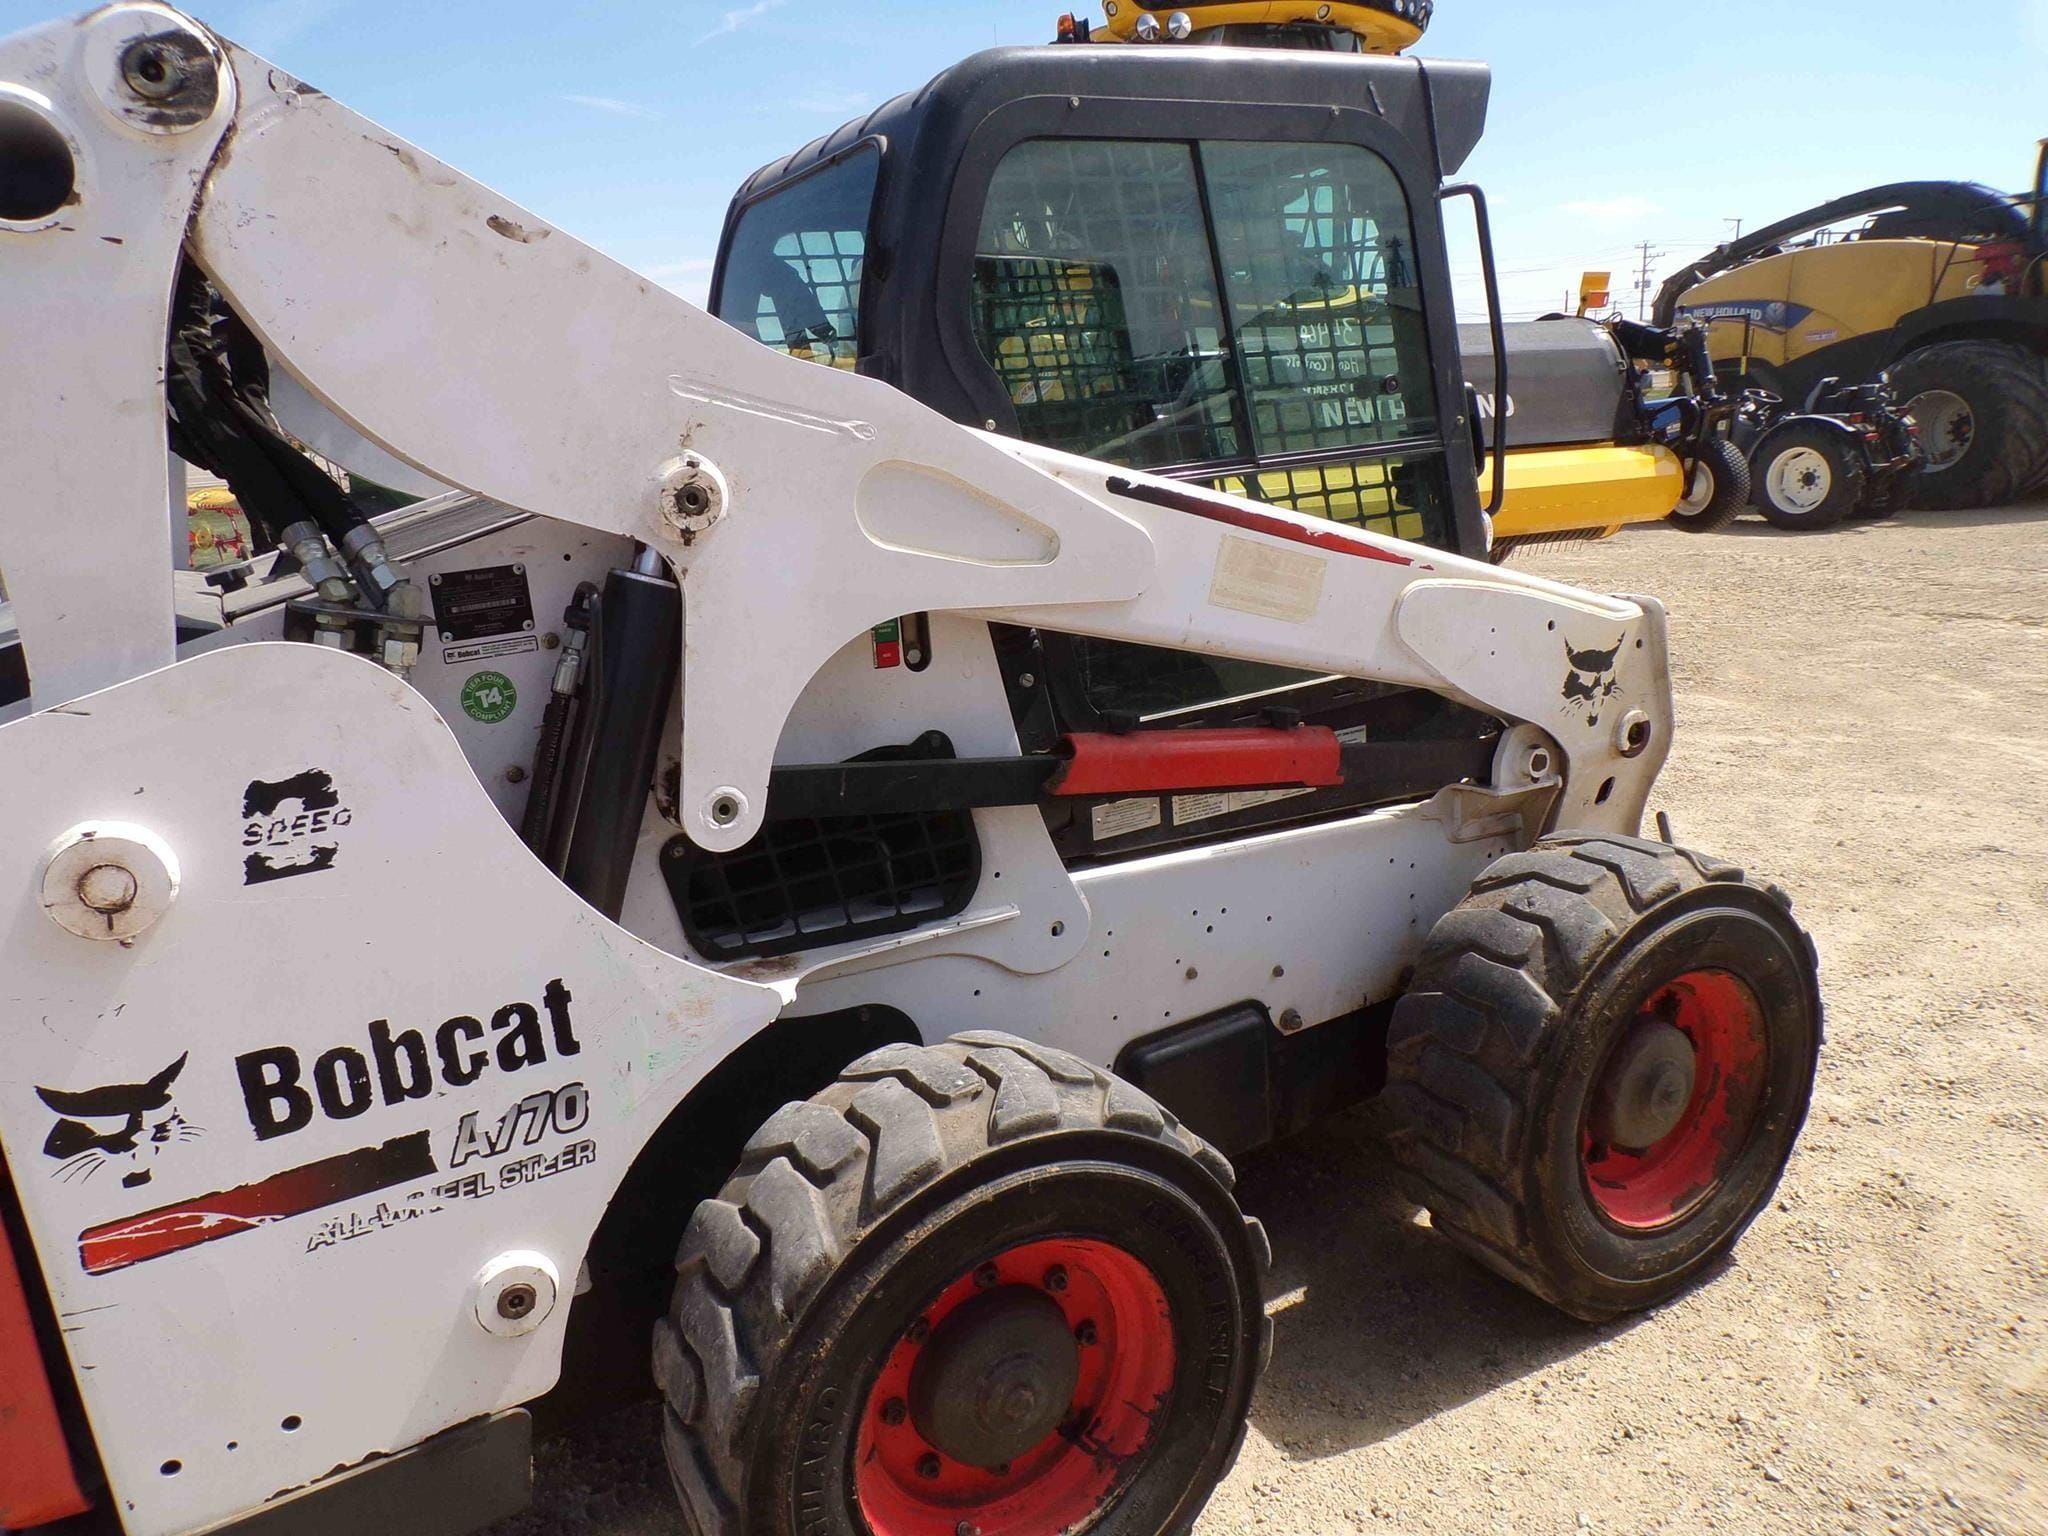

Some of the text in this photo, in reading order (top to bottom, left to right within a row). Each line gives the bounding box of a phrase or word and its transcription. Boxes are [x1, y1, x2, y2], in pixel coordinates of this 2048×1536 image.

[1693, 308, 1713, 318] NEW
[466, 674, 504, 692] TIER FOUR
[475, 687, 503, 708] T4
[470, 700, 512, 720] COMPLIANT
[235, 978, 581, 1141] Bobcat
